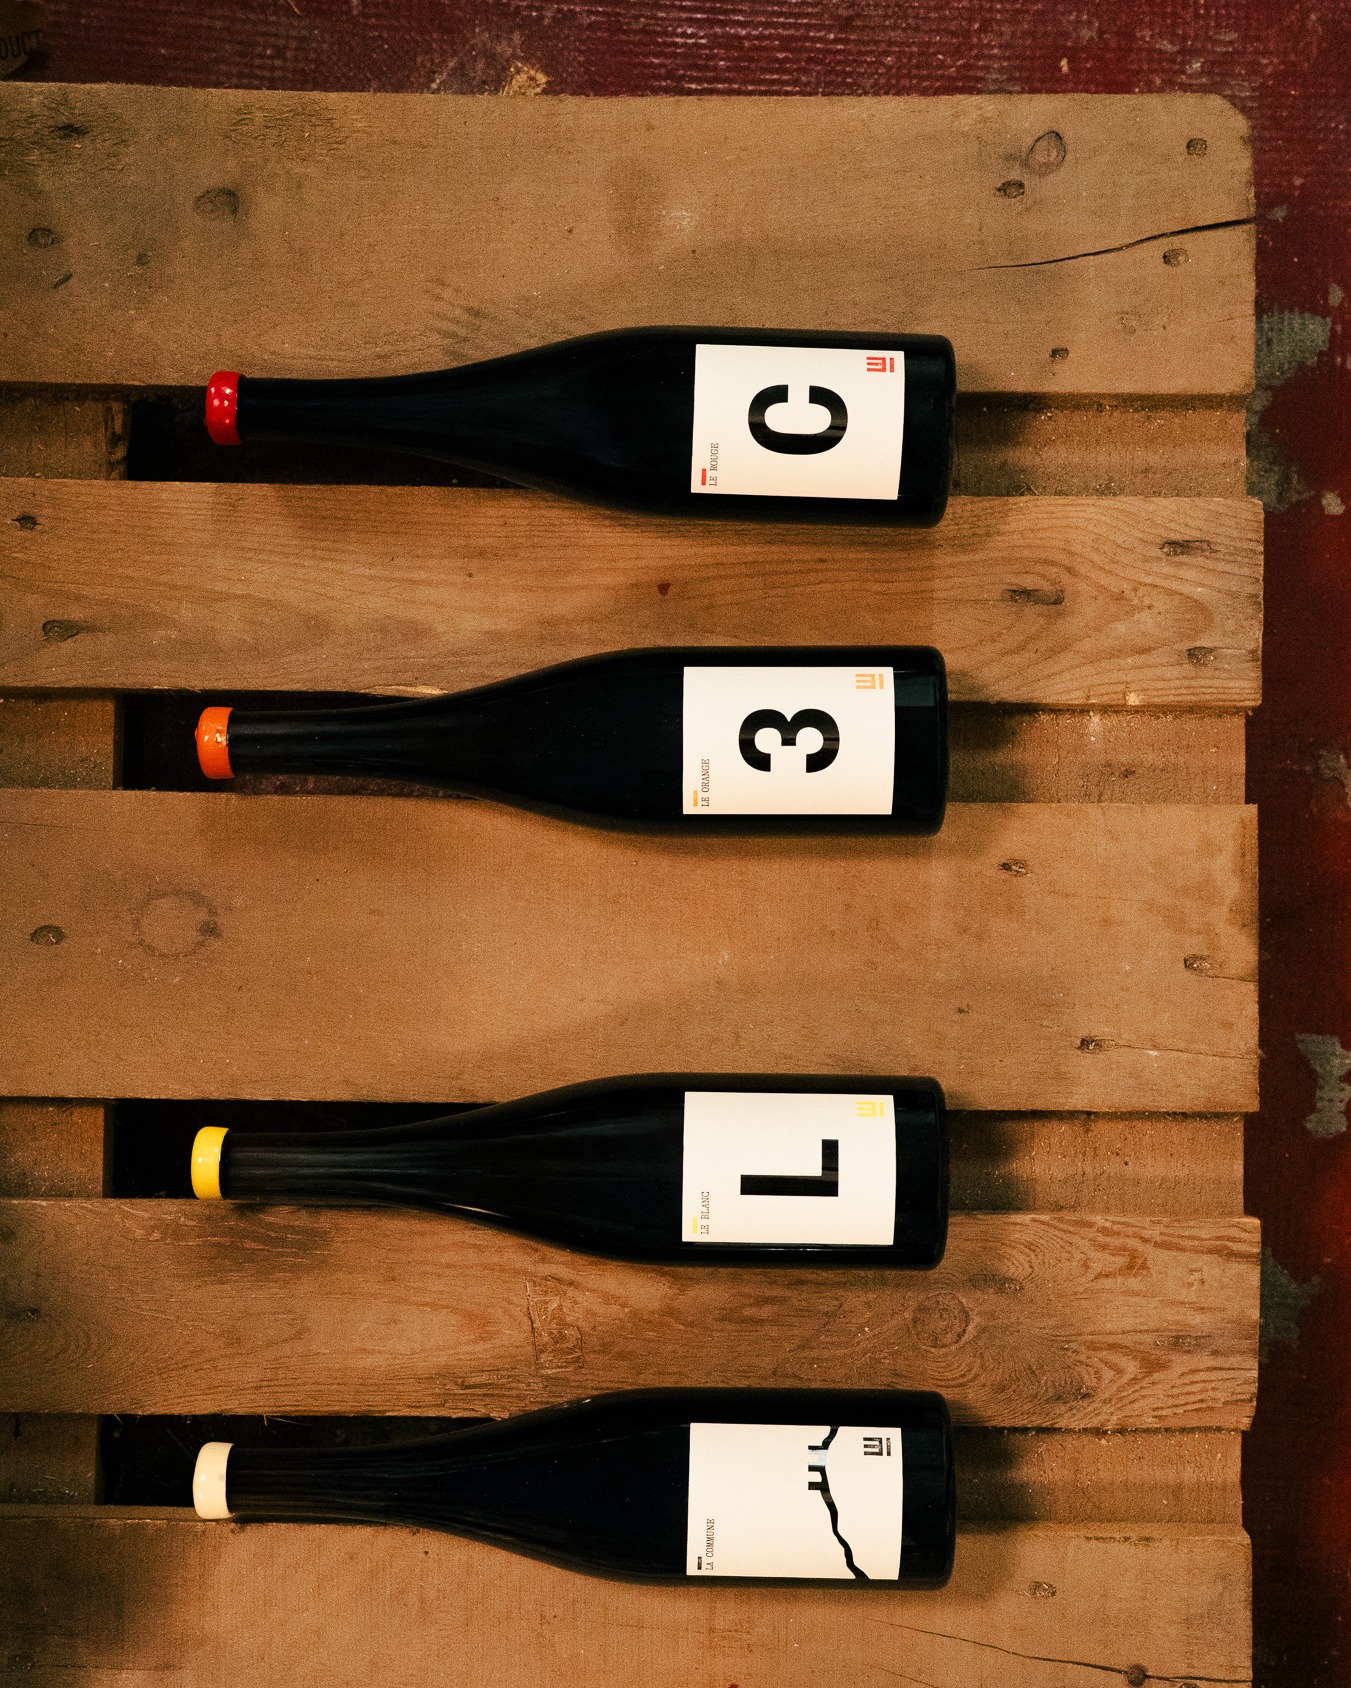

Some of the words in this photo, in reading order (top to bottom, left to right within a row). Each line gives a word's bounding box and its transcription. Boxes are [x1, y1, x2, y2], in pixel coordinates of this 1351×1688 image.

[747, 384, 848, 455] C
[709, 442, 719, 472] ROUGE
[709, 476, 718, 487] LE
[738, 708, 840, 773] 3
[701, 758, 710, 793] ORANGE
[701, 796, 710, 807] LE
[740, 1139, 839, 1196] L
[701, 1191, 710, 1220] BLANC
[700, 1224, 709, 1235] LE
[705, 1518, 715, 1558] COMMUNE
[705, 1561, 714, 1571] LA
